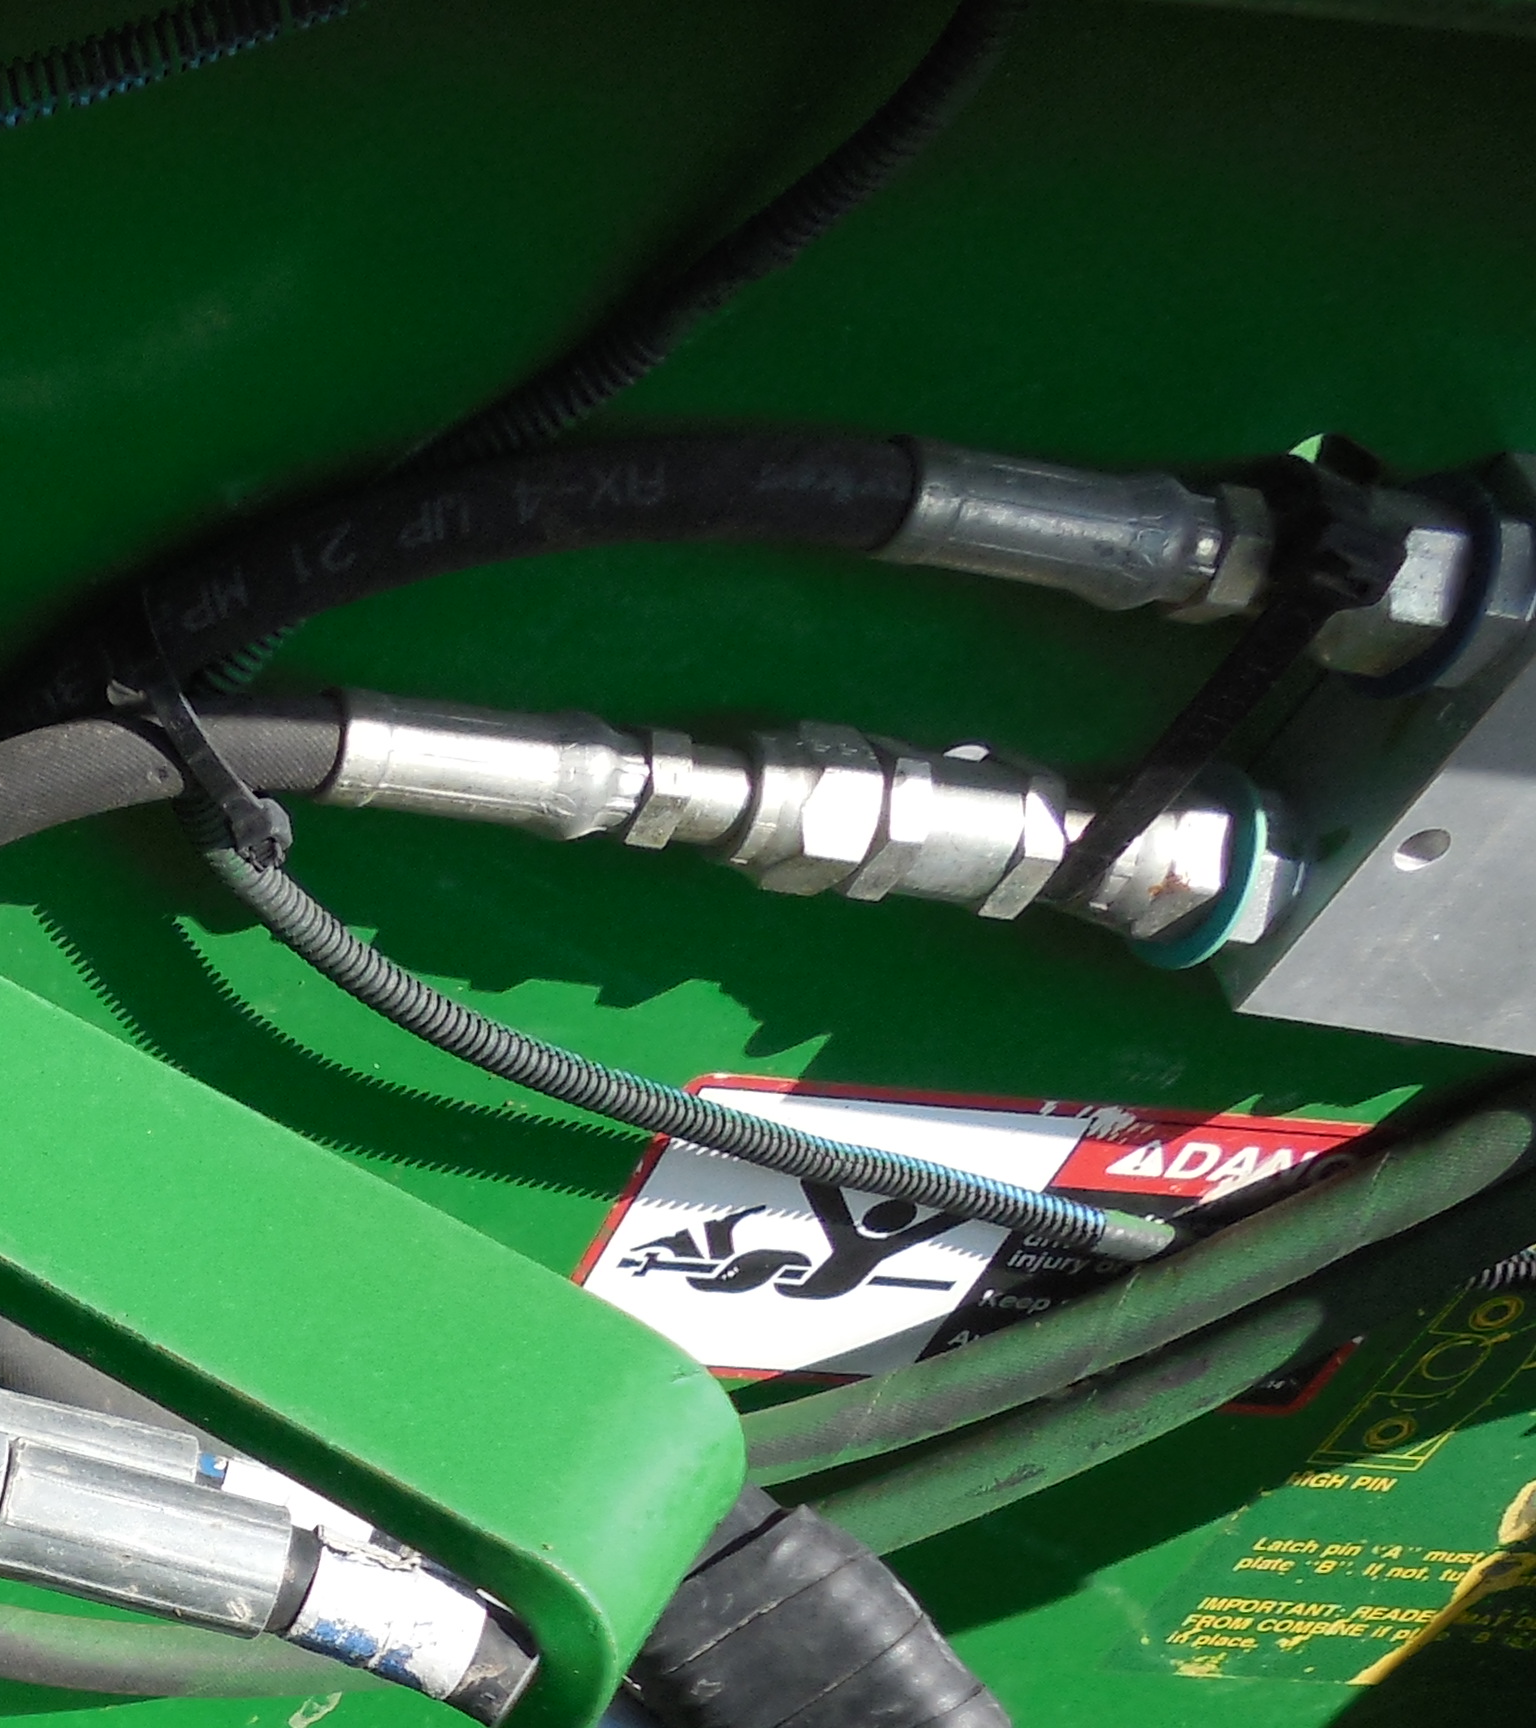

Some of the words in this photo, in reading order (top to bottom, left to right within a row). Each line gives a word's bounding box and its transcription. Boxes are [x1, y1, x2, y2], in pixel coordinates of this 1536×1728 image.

[1006, 1249, 1090, 1274] injury
[979, 1289, 1051, 1314] Keep
[1288, 1471, 1349, 1489] HIGH
[1350, 1474, 1398, 1492] PIN
[1252, 1536, 1320, 1554] Latch
[1320, 1540, 1363, 1558] pin
[1423, 1549, 1486, 1565] must
[1233, 1556, 1296, 1573] plate
[1196, 1596, 1346, 1618] IMPORTANT:
[1181, 1613, 1256, 1630] FROM
[1256, 1618, 1369, 1637] COMBINE
